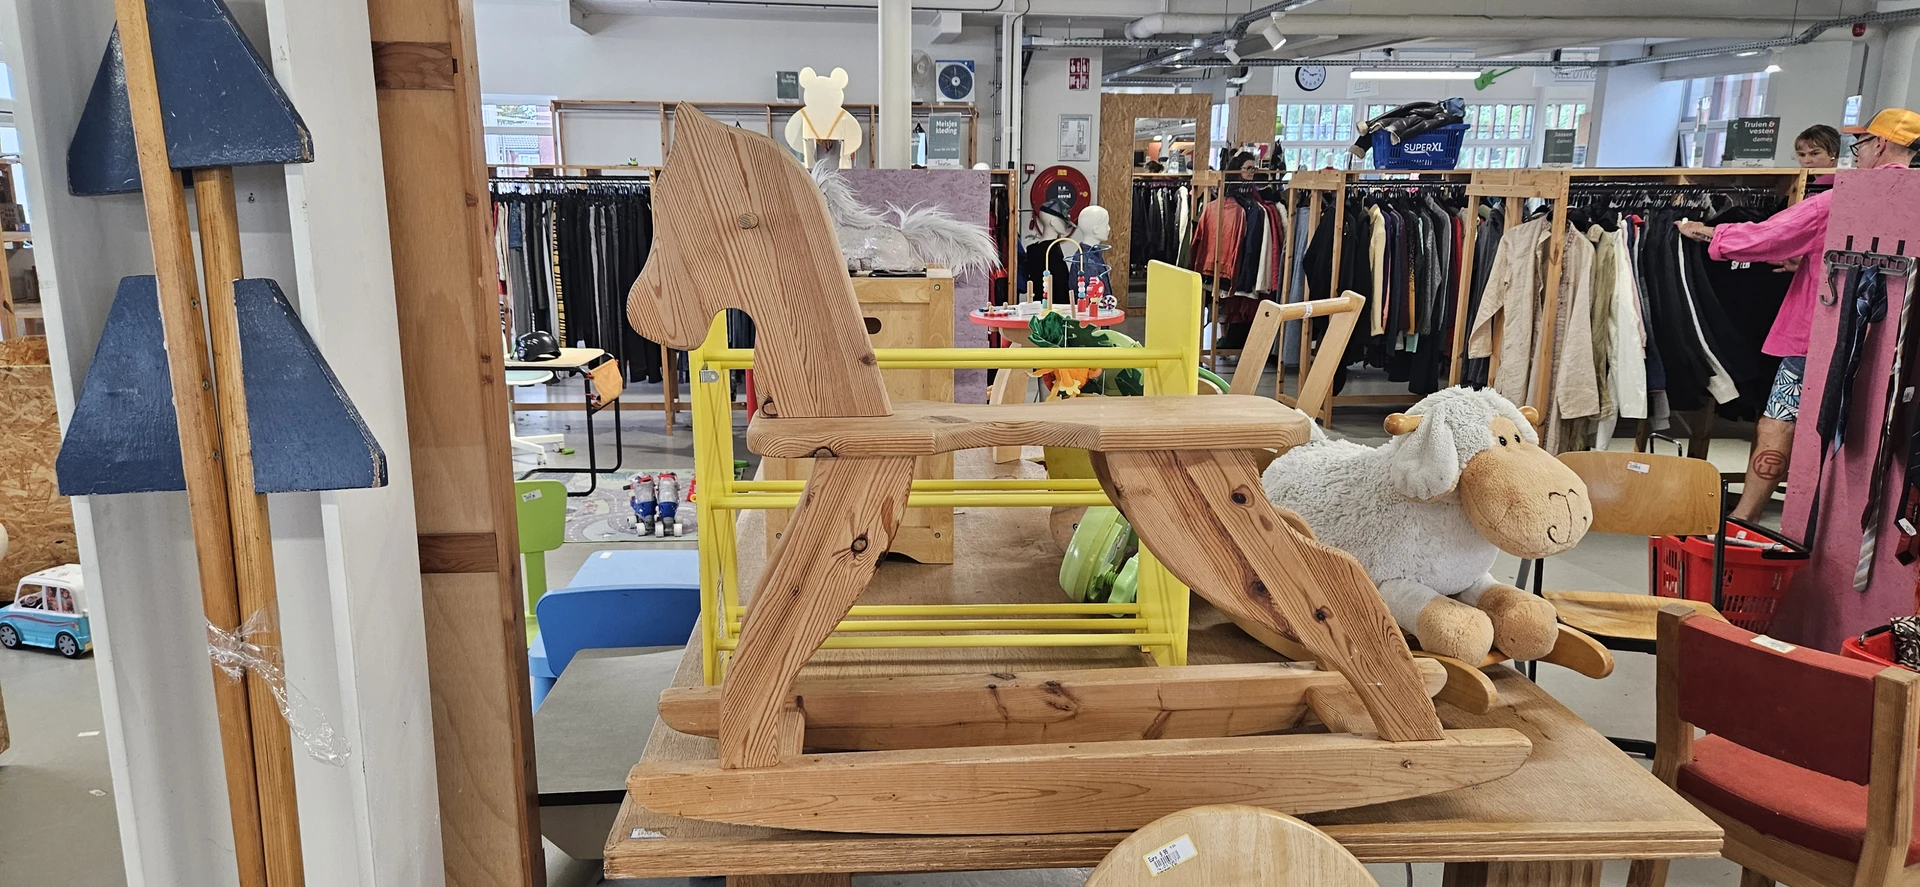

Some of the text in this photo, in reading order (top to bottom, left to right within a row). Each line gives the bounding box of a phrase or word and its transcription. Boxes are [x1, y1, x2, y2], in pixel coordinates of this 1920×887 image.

[936, 120, 958, 129] Meisjes
[936, 127, 958, 136] kleding
[1404, 142, 1444, 152] SUPERXL
